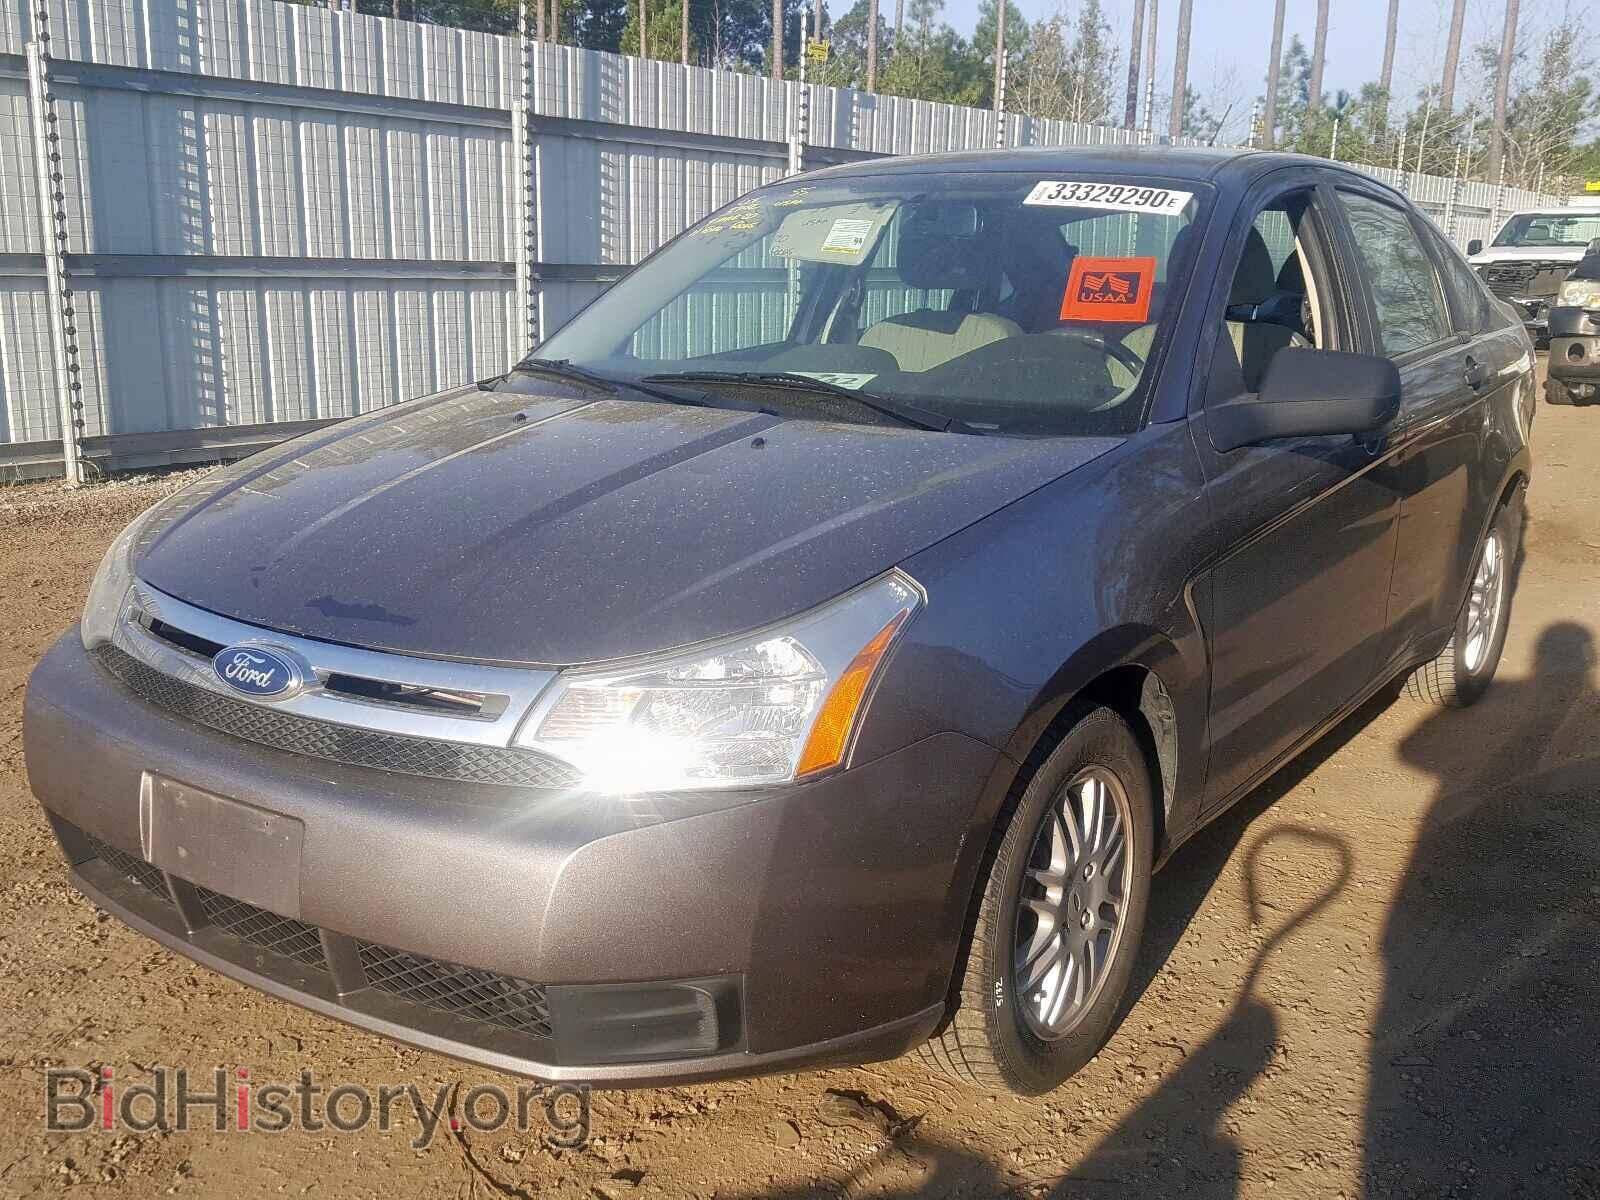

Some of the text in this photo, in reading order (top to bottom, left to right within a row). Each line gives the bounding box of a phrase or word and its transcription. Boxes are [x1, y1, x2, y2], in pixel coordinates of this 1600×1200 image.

[1048, 183, 1169, 208] 33329290
[1080, 293, 1127, 303] USAA
[225, 652, 275, 687] Ford
